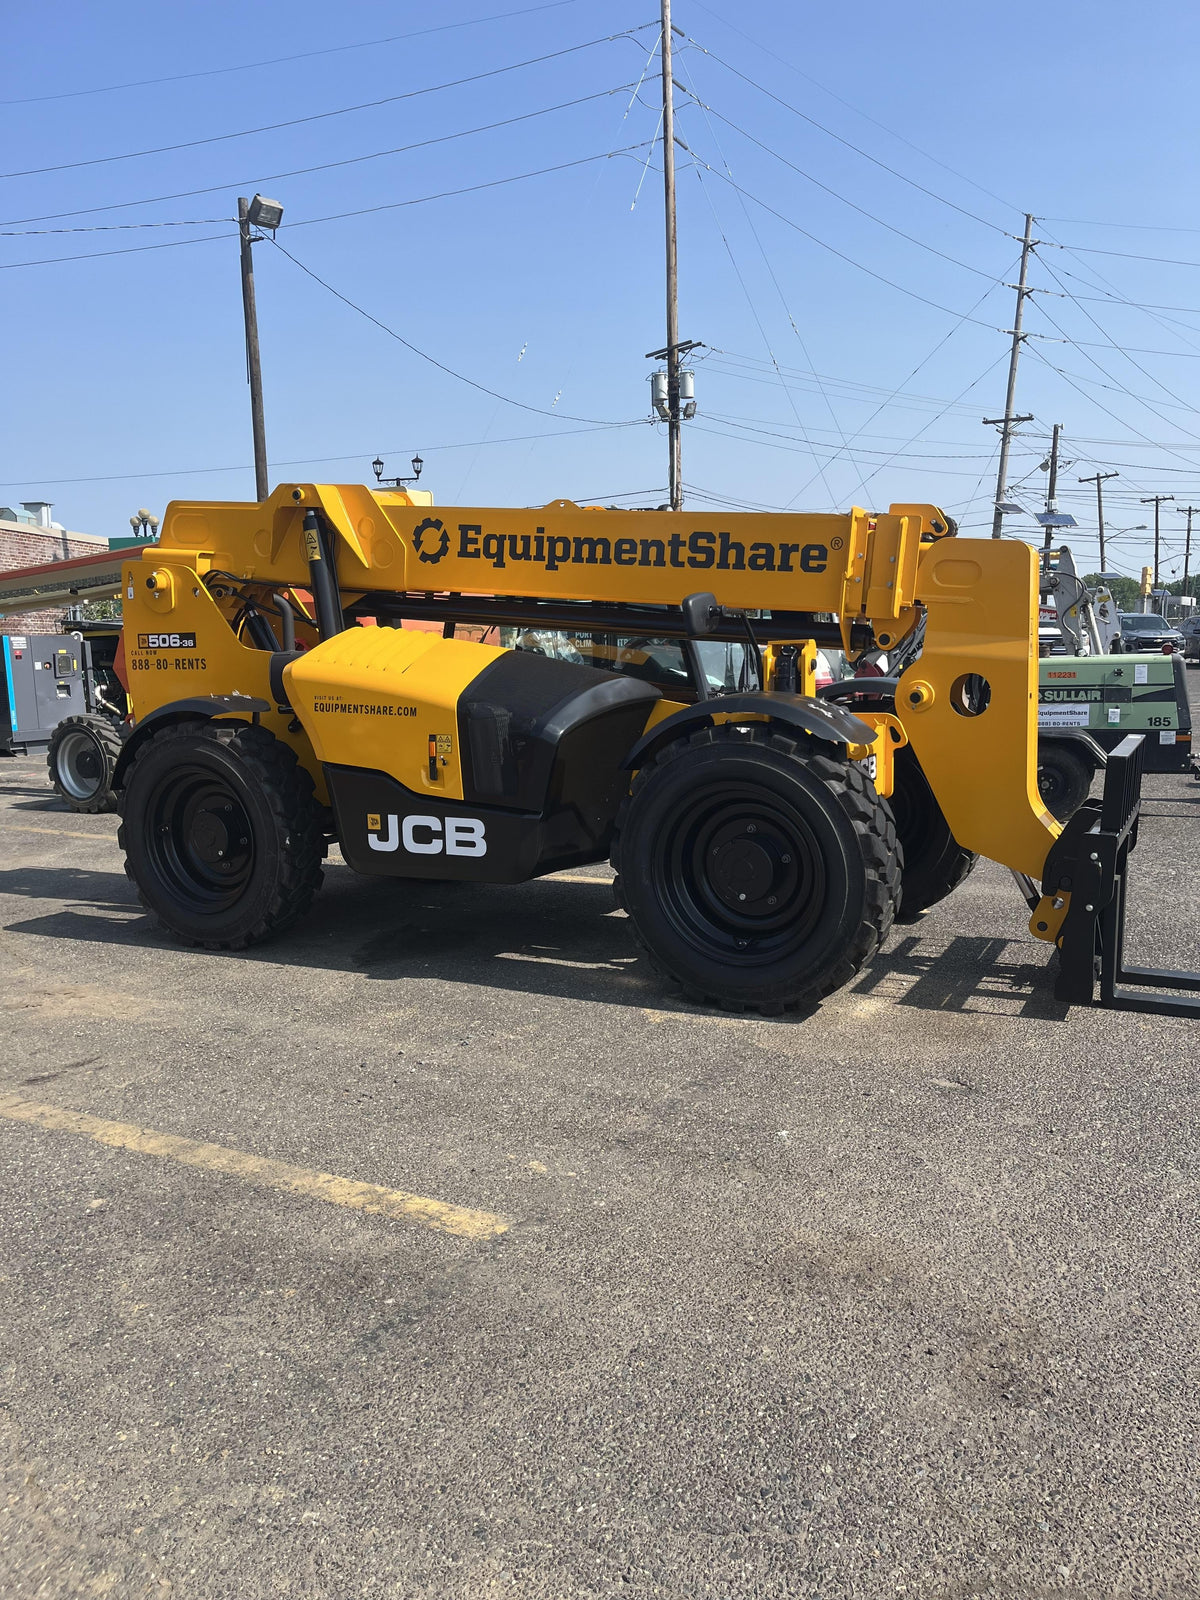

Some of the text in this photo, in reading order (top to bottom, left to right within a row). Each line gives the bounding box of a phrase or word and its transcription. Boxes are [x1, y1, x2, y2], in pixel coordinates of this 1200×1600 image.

[148, 634, 193, 647] 506-36
[132, 658, 207, 670] 888-80-RENTS
[1044, 690, 1101, 701] SULLAIR
[314, 702, 417, 717] EQUIPMENTSHARE.COM
[1147, 716, 1172, 727] 185
[367, 814, 487, 857] JCB
